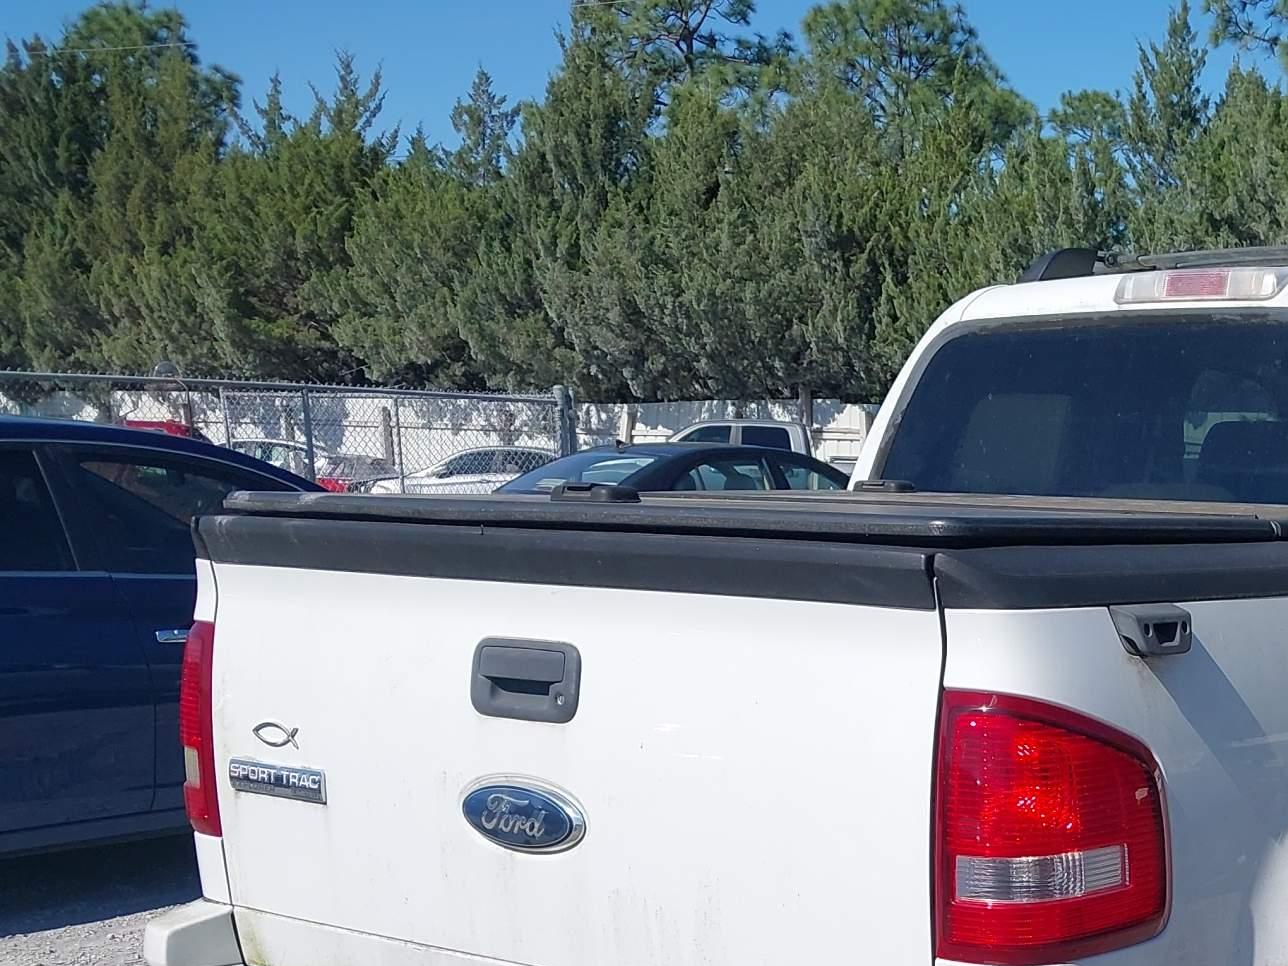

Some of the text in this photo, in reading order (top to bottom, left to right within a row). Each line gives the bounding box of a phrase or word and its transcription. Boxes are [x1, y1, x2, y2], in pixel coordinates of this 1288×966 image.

[230, 763, 277, 784] SPORT
[281, 770, 320, 789] TRAC
[481, 793, 548, 837] Ford
